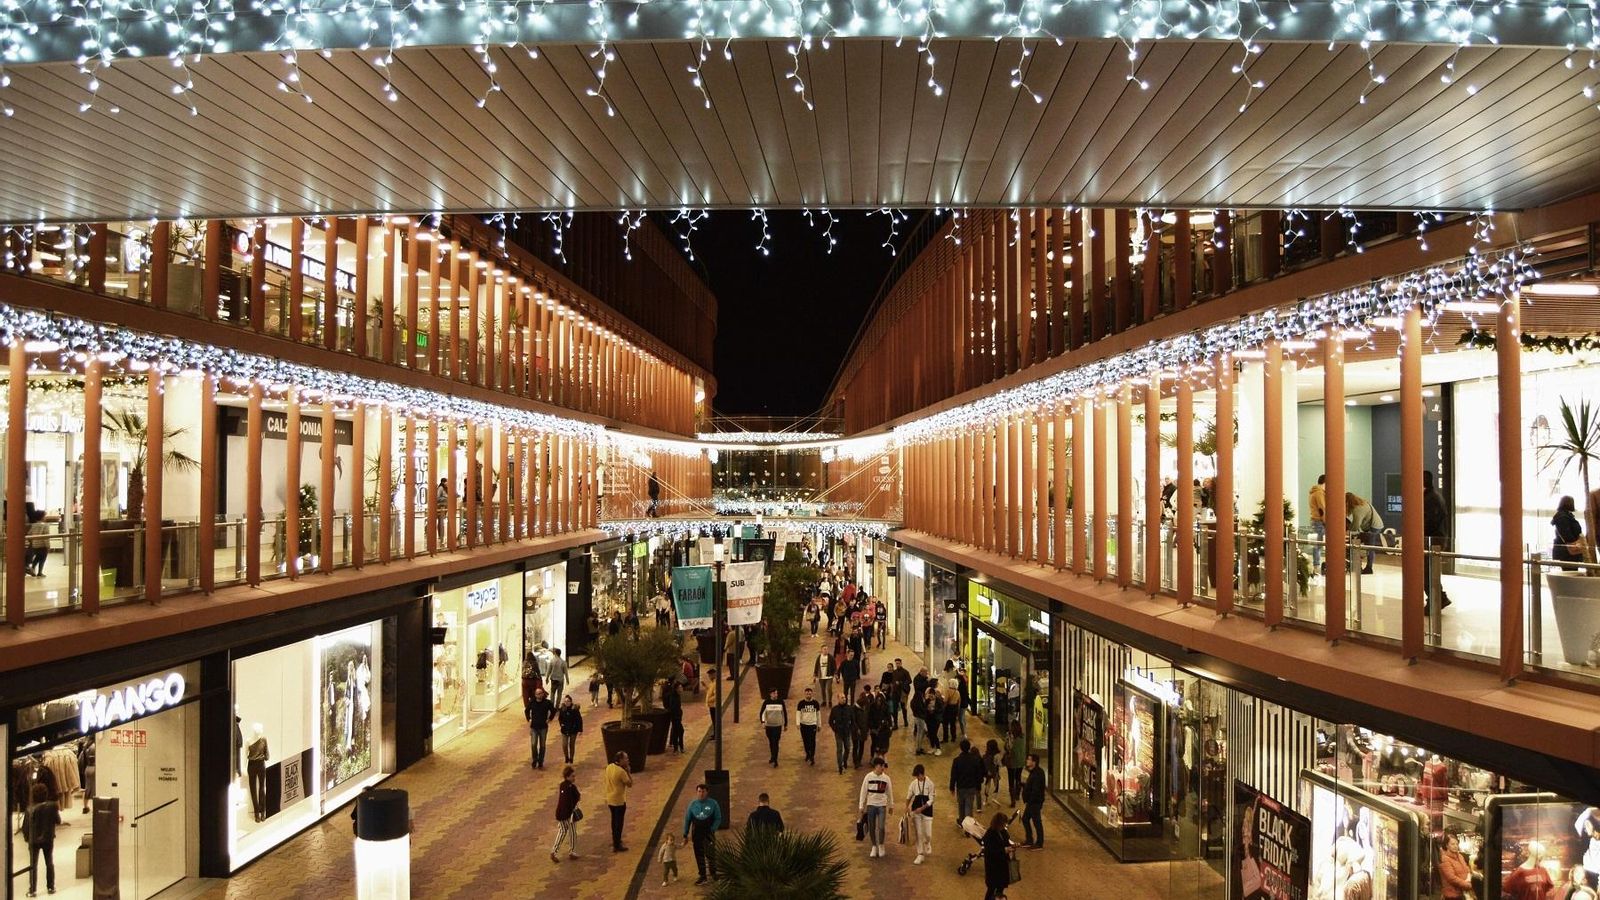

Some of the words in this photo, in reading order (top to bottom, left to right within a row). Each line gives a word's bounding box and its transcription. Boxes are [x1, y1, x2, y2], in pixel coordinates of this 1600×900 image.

[80, 672, 185, 734] MANGO
[1259, 807, 1293, 850] BLACK
[1259, 834, 1293, 875] FRIDAY
